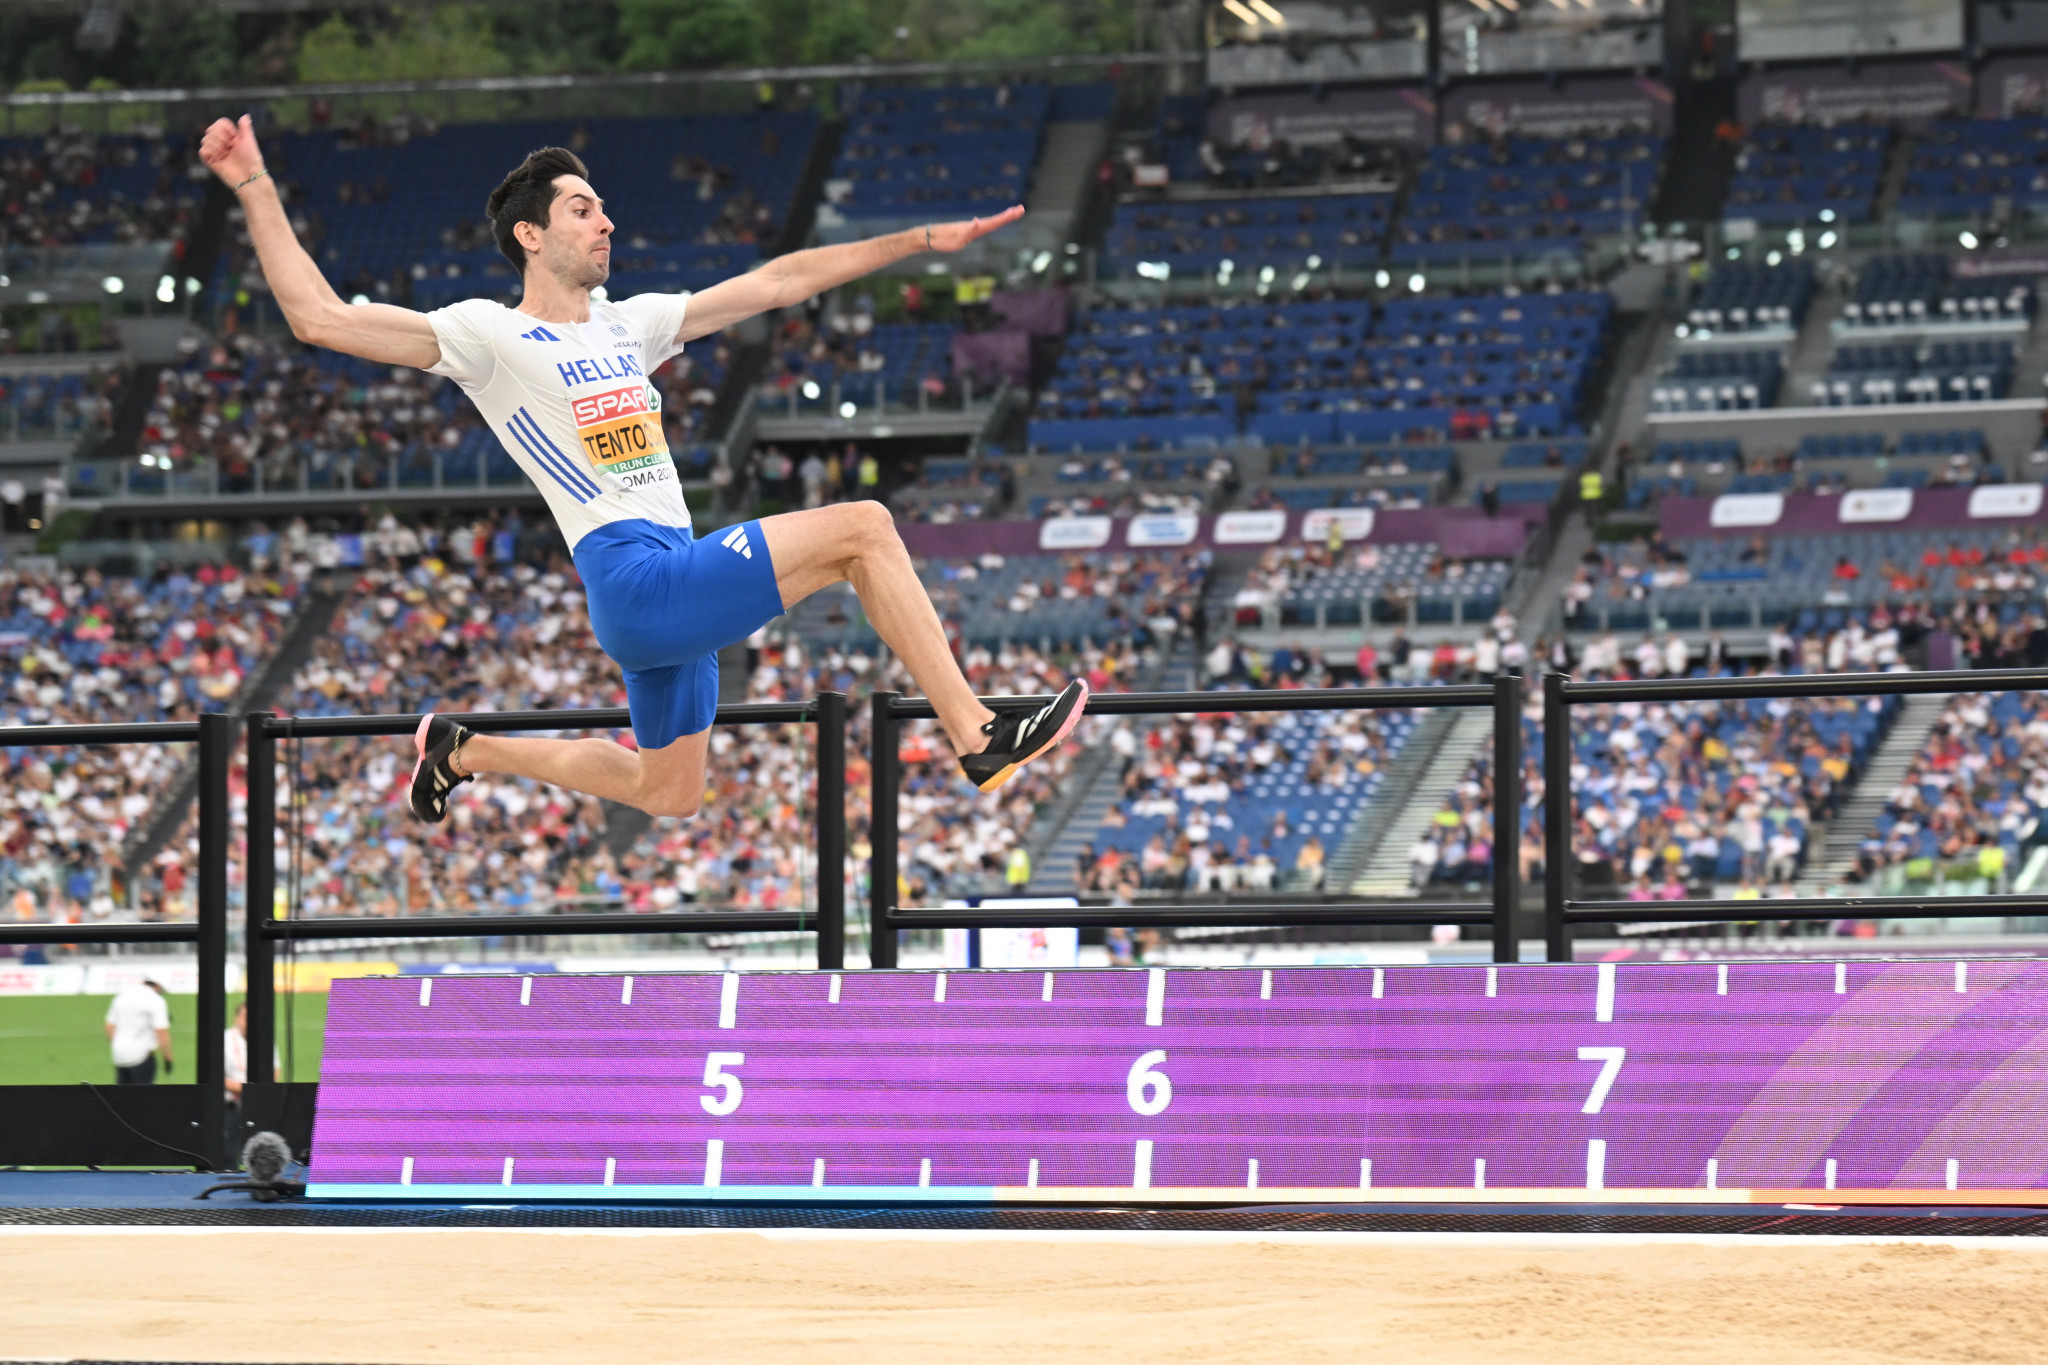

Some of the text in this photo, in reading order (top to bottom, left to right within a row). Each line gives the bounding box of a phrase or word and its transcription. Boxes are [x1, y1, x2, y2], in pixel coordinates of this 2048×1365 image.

[557, 353, 643, 387] HELLAS
[575, 388, 647, 422] SPAR
[584, 421, 666, 460] TENTO
[613, 464, 619, 473] I
[619, 458, 644, 472] RUN
[621, 471, 656, 488] OMA
[699, 1051, 746, 1116] 5
[1126, 1049, 1173, 1116] 6
[1577, 1046, 1626, 1114] 7
